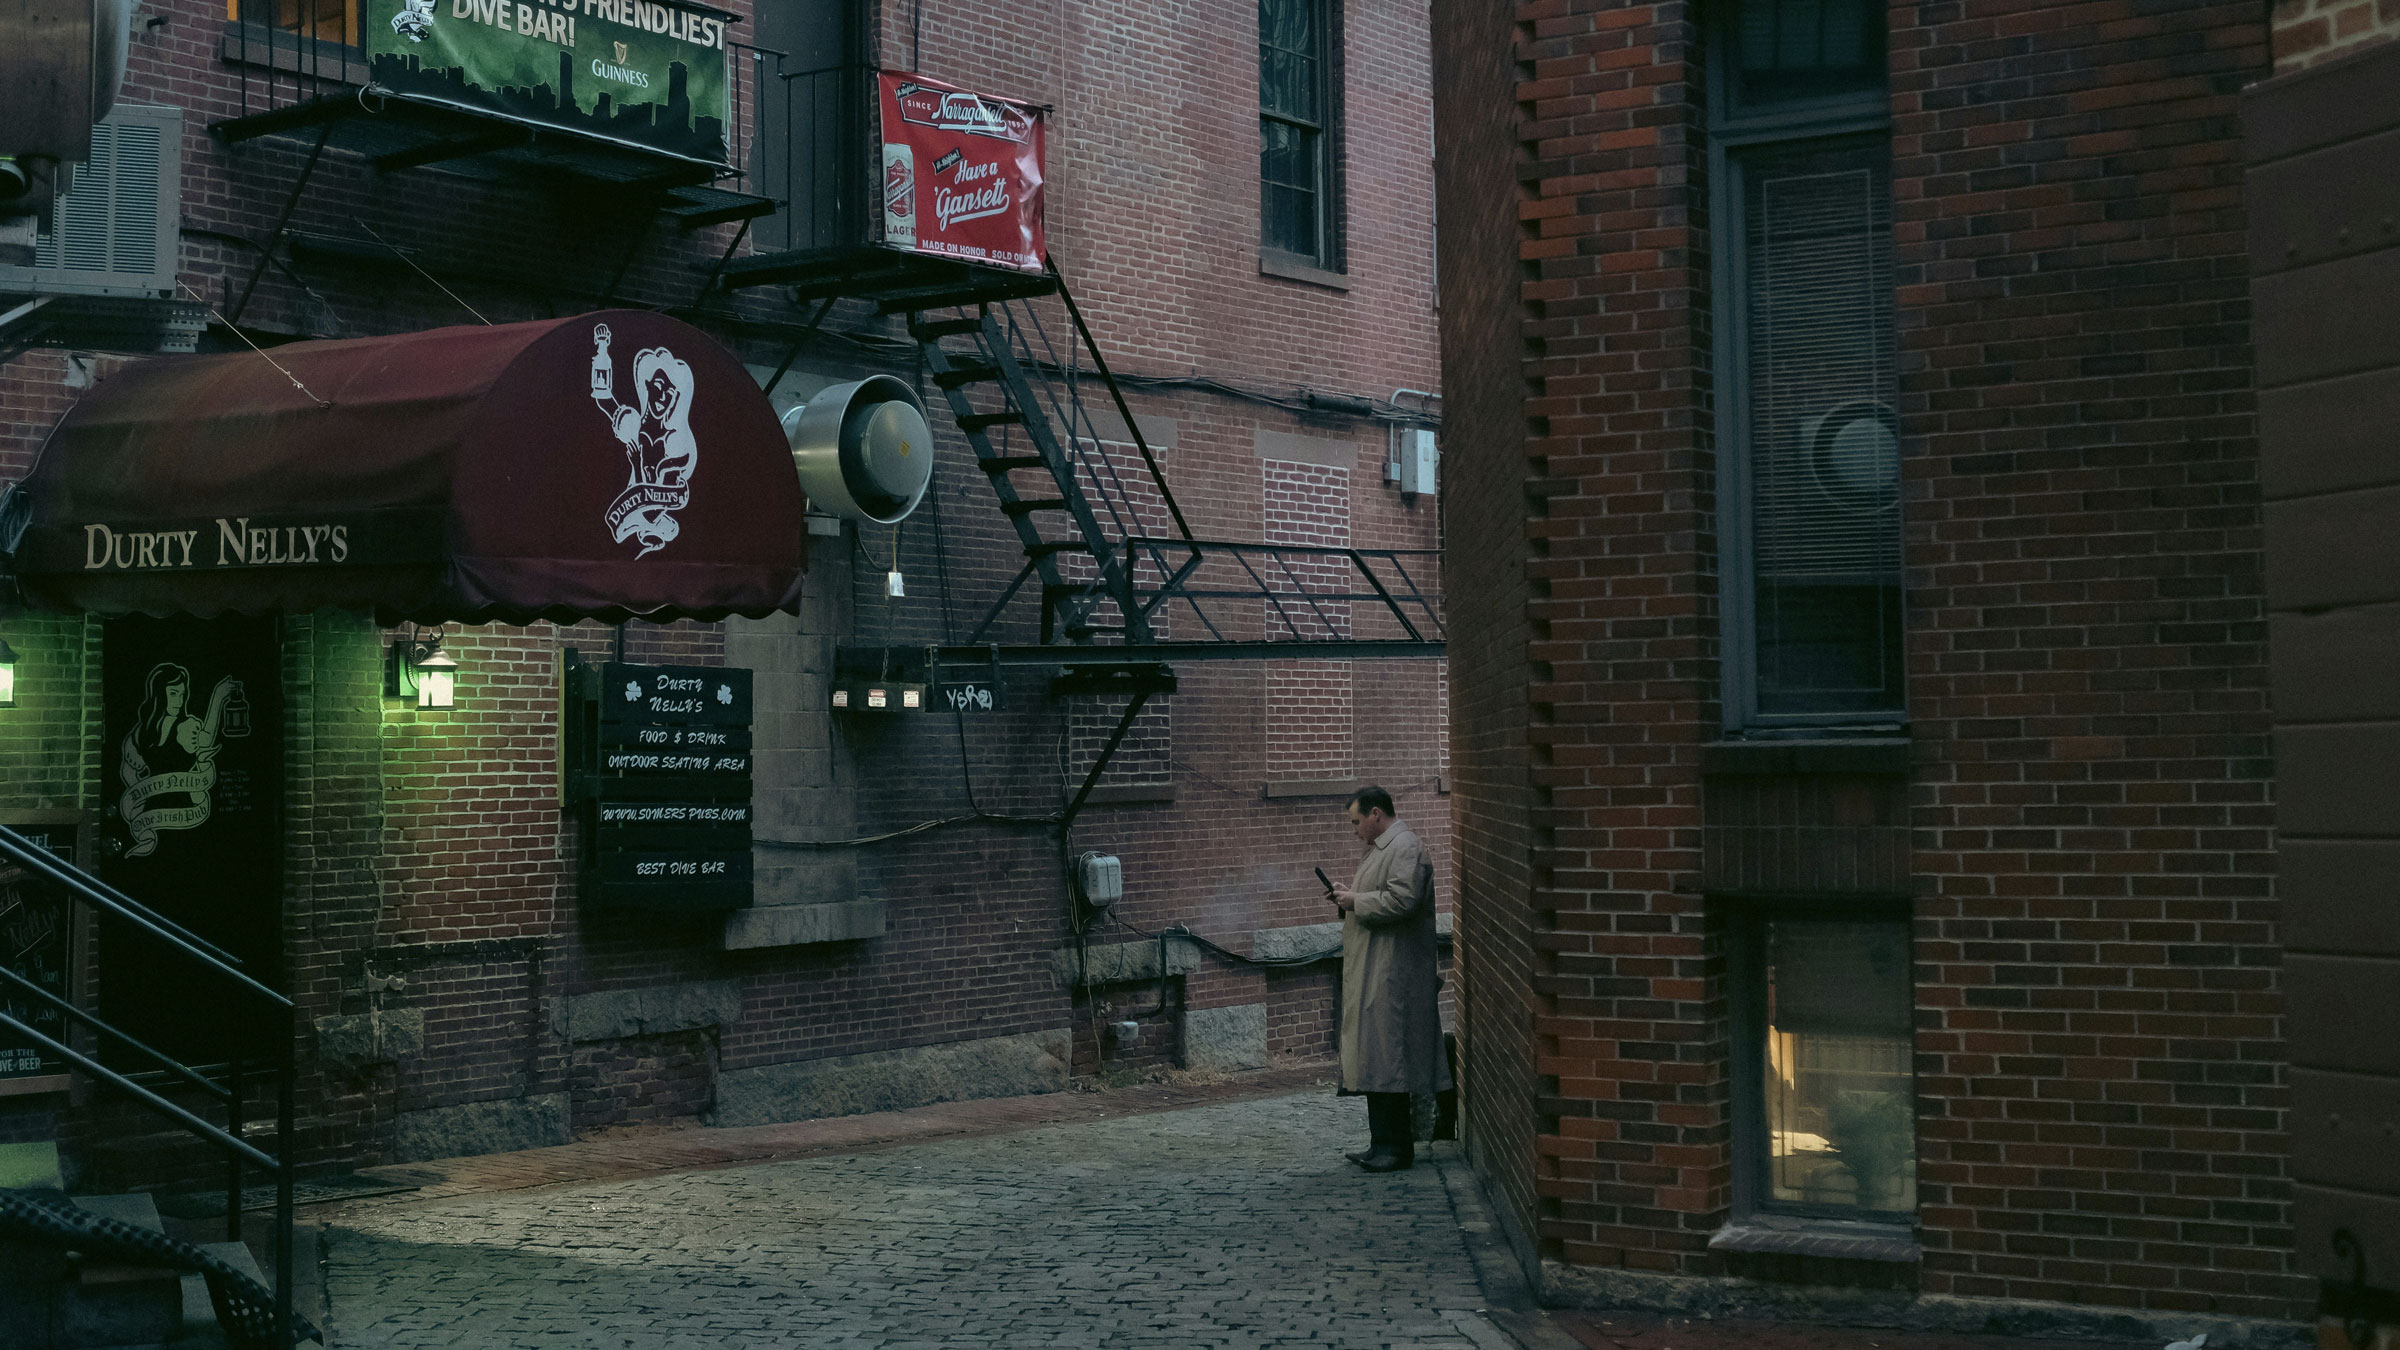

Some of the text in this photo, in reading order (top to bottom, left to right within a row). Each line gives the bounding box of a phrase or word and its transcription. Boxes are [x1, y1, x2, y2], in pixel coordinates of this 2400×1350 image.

[452, 0, 575, 47] DIVE BAR!
[583, 0, 724, 50] FRIENDLIEST
[592, 58, 649, 88] GUINNESS
[907, 100, 931, 111] SINCE
[954, 160, 999, 185] Have a
[886, 223, 916, 236] LAGER
[922, 240, 946, 252] MADE
[947, 242, 959, 254] ON
[960, 244, 987, 258] HONOR
[992, 249, 1013, 261] SOLD
[609, 491, 642, 527] DURTY
[84, 517, 348, 569] DURTY NELLY'S
[656, 674, 704, 692] DURTY
[650, 696, 704, 713] NELLY'S
[639, 730, 668, 744] FOOD
[687, 732, 727, 745] DRINK
[608, 755, 745, 771] OUTDOOR SEATING AREA
[132, 805, 207, 832] Olde Irish Pub
[636, 860, 726, 876] BEST DIVE BAR
[19, 1057, 41, 1071] BEER
